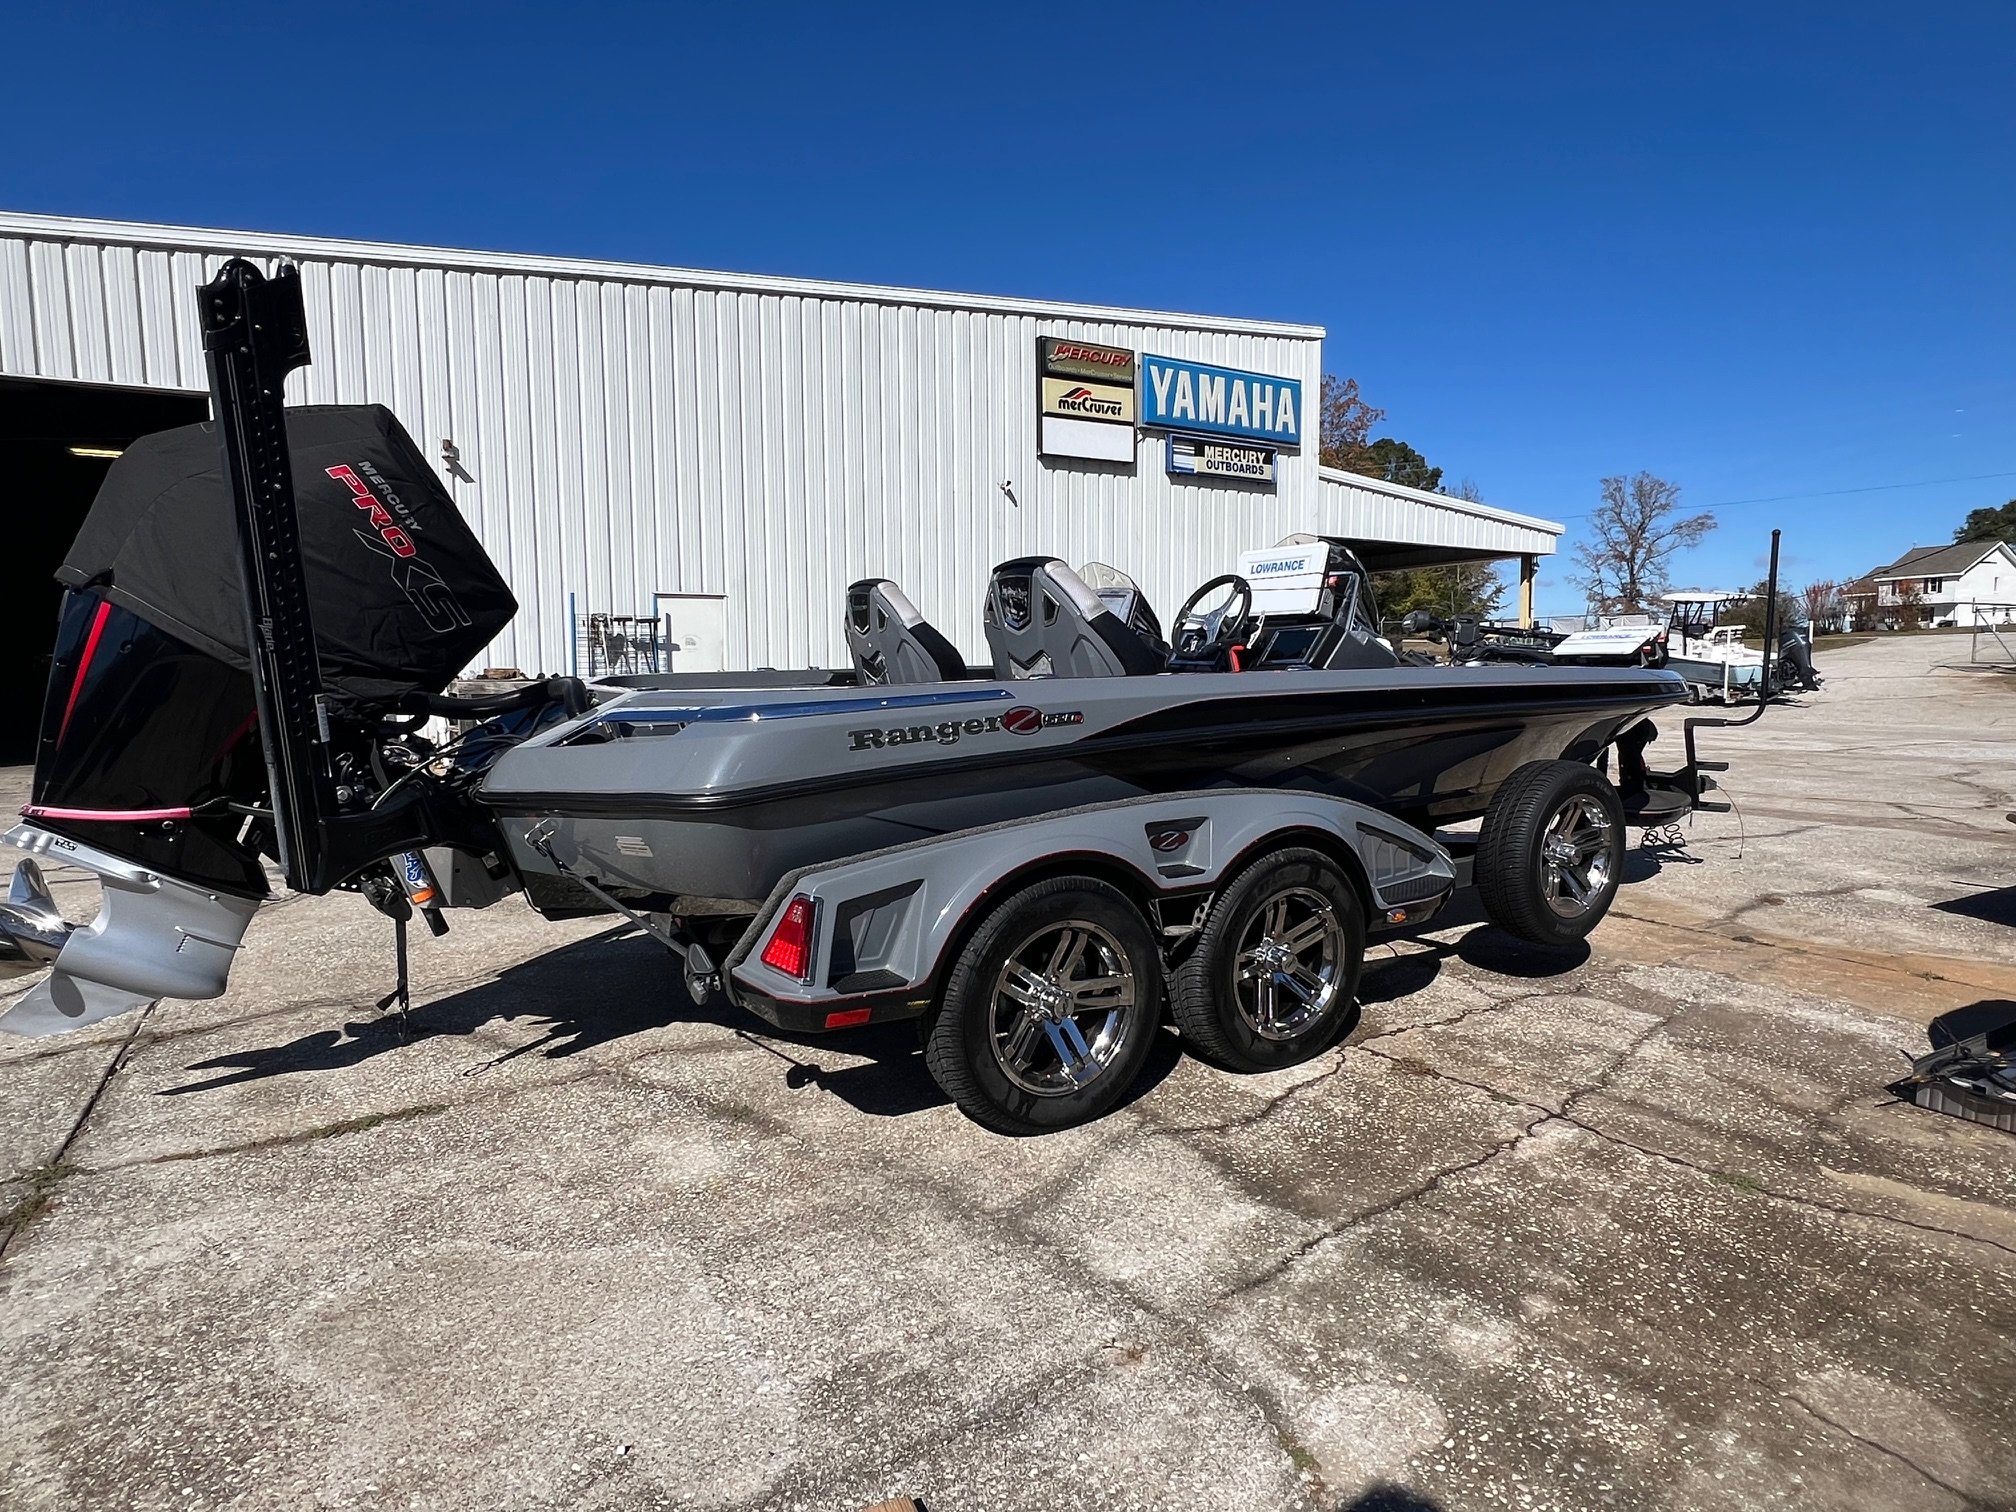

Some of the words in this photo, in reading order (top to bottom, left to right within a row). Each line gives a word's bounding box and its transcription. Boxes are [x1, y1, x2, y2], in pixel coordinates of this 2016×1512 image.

[1053, 344, 1131, 367] MERCURY
[1058, 397, 1122, 416] merCruiser
[1150, 365, 1296, 435] YAMAHA
[1204, 445, 1266, 465] MERCURY
[1206, 460, 1264, 475] OUTBOARDS
[358, 460, 422, 532] MERCURY
[325, 464, 417, 558] PRO
[352, 524, 472, 632] XS
[1250, 559, 1305, 575] LOWRANCE
[848, 716, 1006, 751] Ranger
